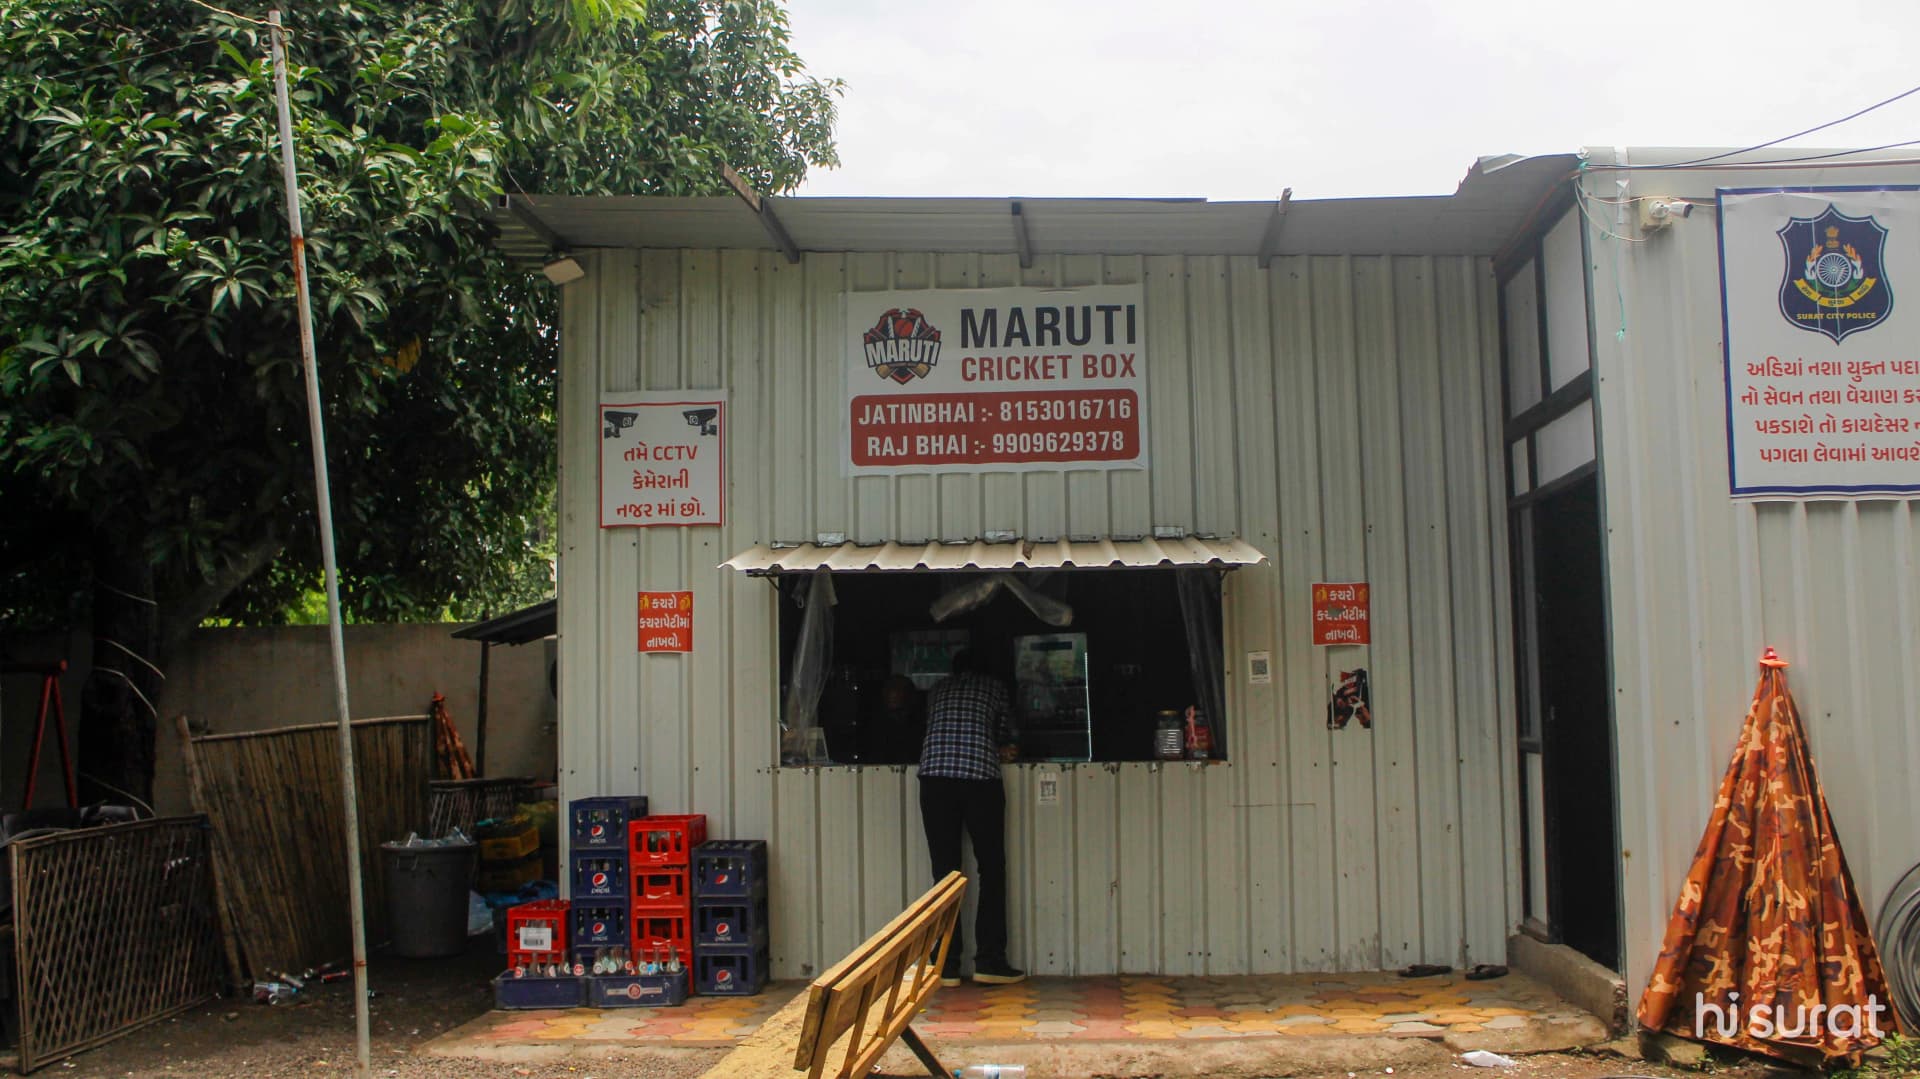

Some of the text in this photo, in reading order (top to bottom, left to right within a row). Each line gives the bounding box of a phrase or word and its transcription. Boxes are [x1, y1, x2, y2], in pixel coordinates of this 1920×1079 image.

[961, 304, 1136, 349] MARUTI
[1796, 312, 1825, 320] SURAT
[1826, 312, 1845, 320] CITY
[866, 339, 941, 367] MARUTI
[961, 353, 1137, 382] CRICKET BOX
[1747, 356, 1803, 377] અહિયાં
[1808, 361, 1842, 376] નશા
[1847, 360, 1885, 383] યુક્ત
[1741, 385, 1759, 406] નો
[1763, 385, 1803, 406] સેવન
[1809, 390, 1841, 405] તથા
[1846, 384, 1898, 404] વેચાણ
[858, 402, 975, 425] JATINBHAI
[1000, 399, 1131, 422] 8153016716
[1755, 413, 1814, 434] પકડાશે
[1819, 413, 1836, 433] તો
[1841, 412, 1909, 433] કાયદેસર
[624, 441, 698, 461] તમે CCTV
[867, 435, 909, 457] RAJ
[916, 434, 967, 456] BHAI
[992, 431, 1124, 454] 9909629378
[1760, 448, 1808, 463] પગલા
[1813, 442, 1866, 462] લેવામાં
[632, 468, 688, 490] કેમેરાની
[616, 502, 653, 518] નજર
[657, 498, 675, 517] માં
[652, 593, 677, 609] કચરો
[1329, 585, 1355, 601] કચરો
